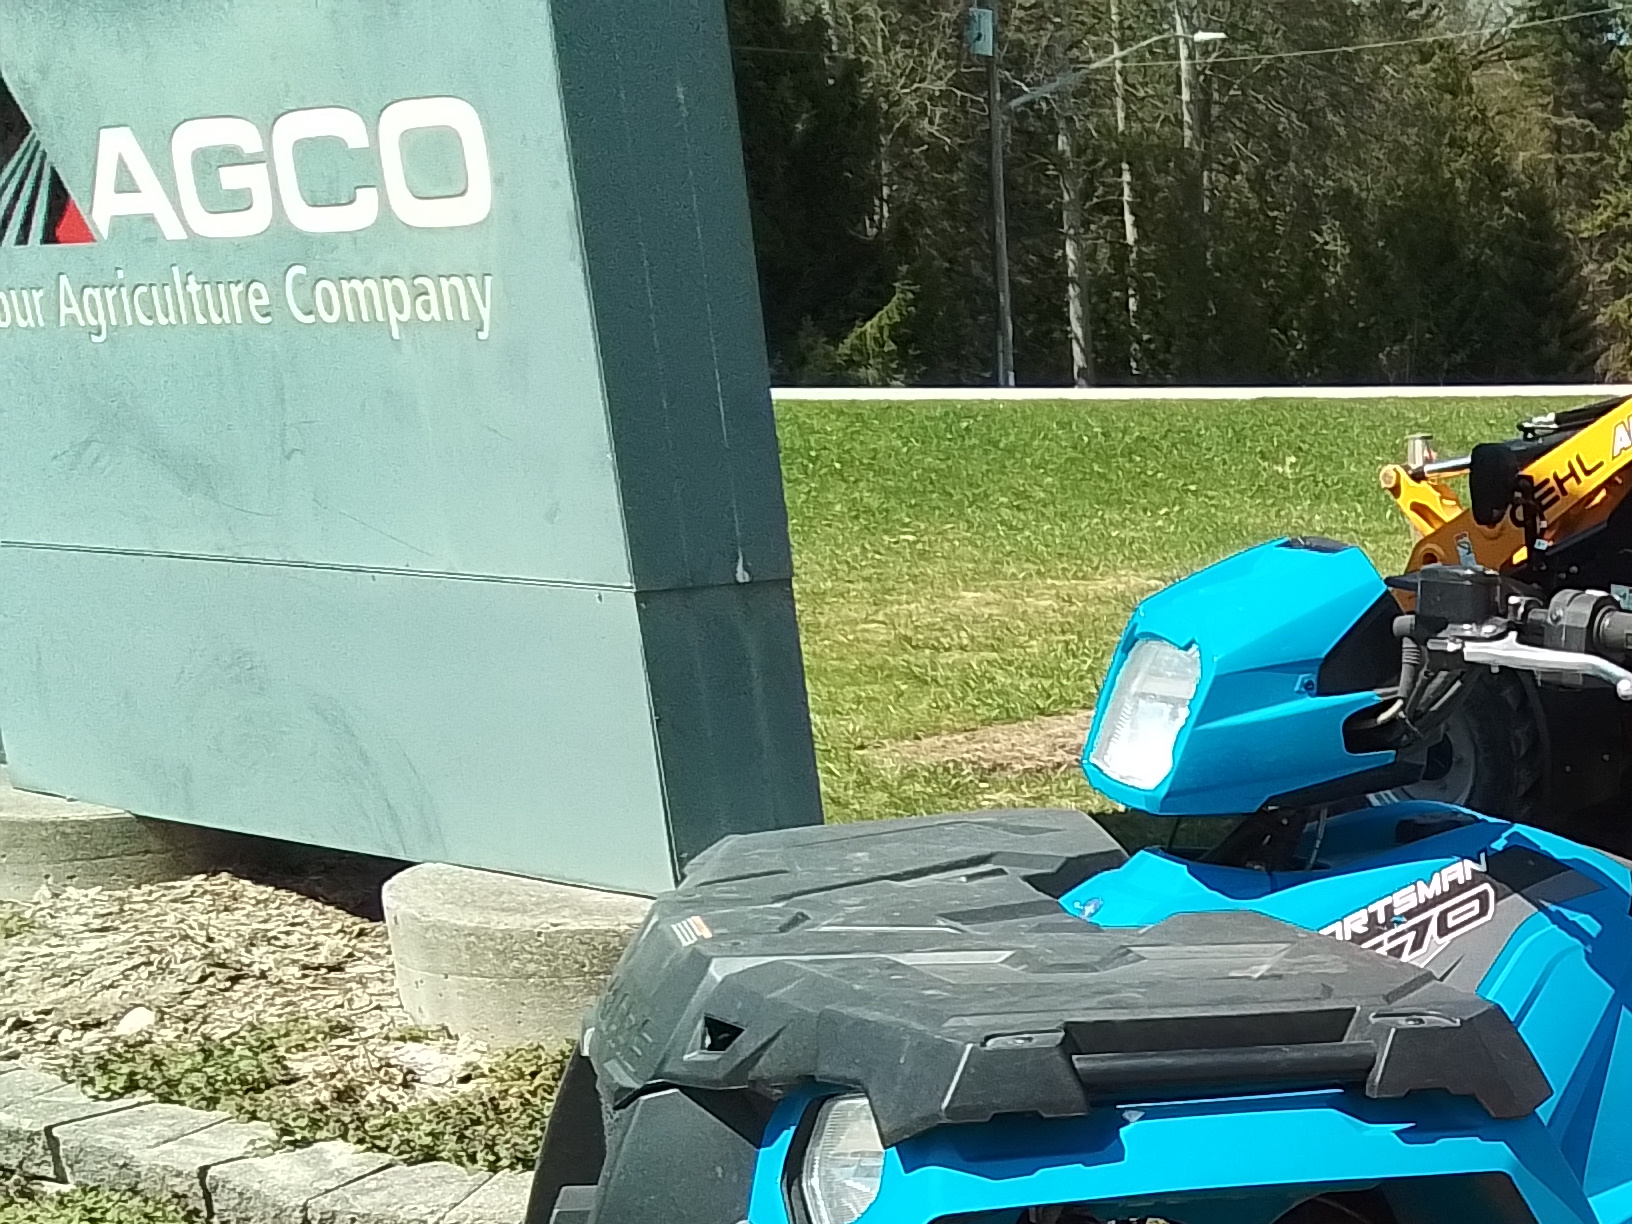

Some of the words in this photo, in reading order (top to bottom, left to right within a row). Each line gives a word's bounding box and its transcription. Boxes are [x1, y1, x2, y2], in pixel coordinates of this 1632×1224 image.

[91, 96, 492, 240] AGCO
[58, 264, 273, 343] Agriculture
[285, 263, 493, 341] Company
